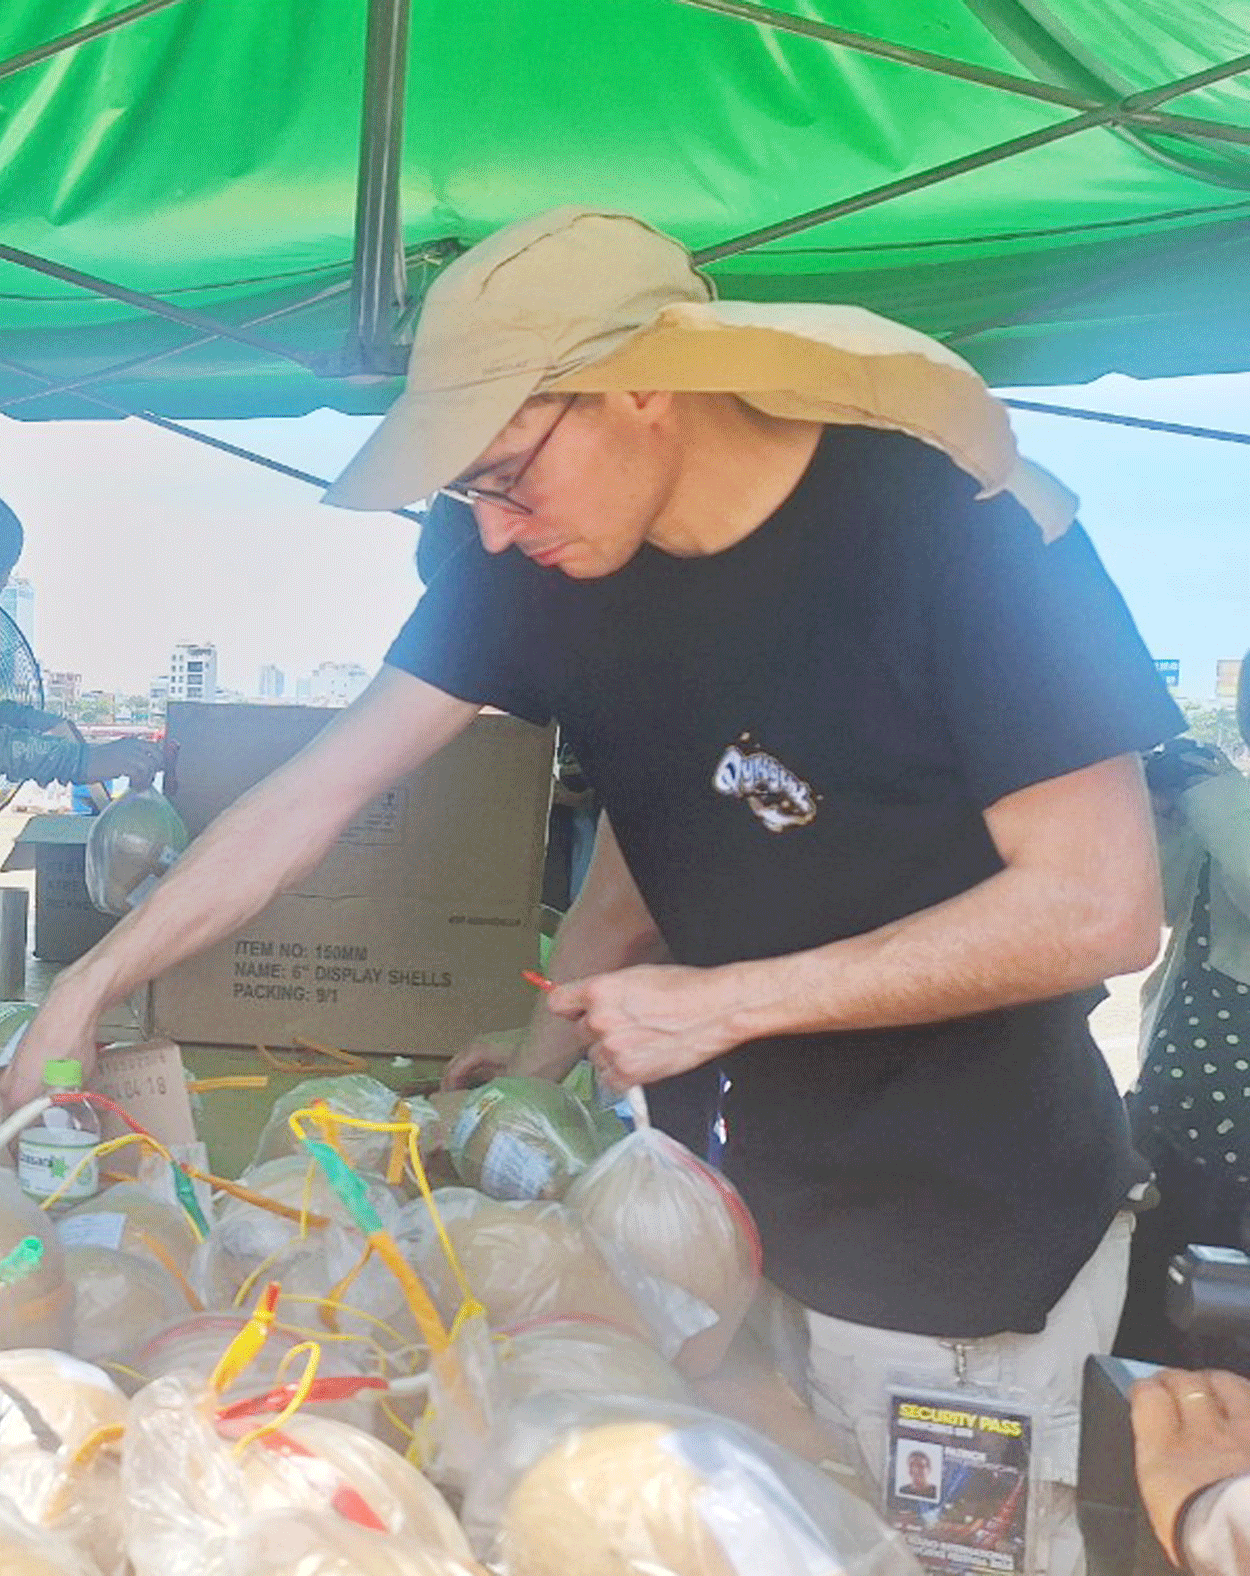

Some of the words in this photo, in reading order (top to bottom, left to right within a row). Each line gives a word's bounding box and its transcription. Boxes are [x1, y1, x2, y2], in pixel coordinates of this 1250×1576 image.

[234, 940, 275, 957] ITEM
[279, 942, 308, 959] NO:
[315, 943, 368, 961] 150MM
[234, 961, 286, 979] NAME:
[314, 965, 383, 985] DISPLAY
[388, 969, 452, 987] SHELLS
[233, 982, 310, 1002] PACKING:
[898, 1403, 978, 1429] SECURITY
[978, 1415, 1023, 1438] PASS
